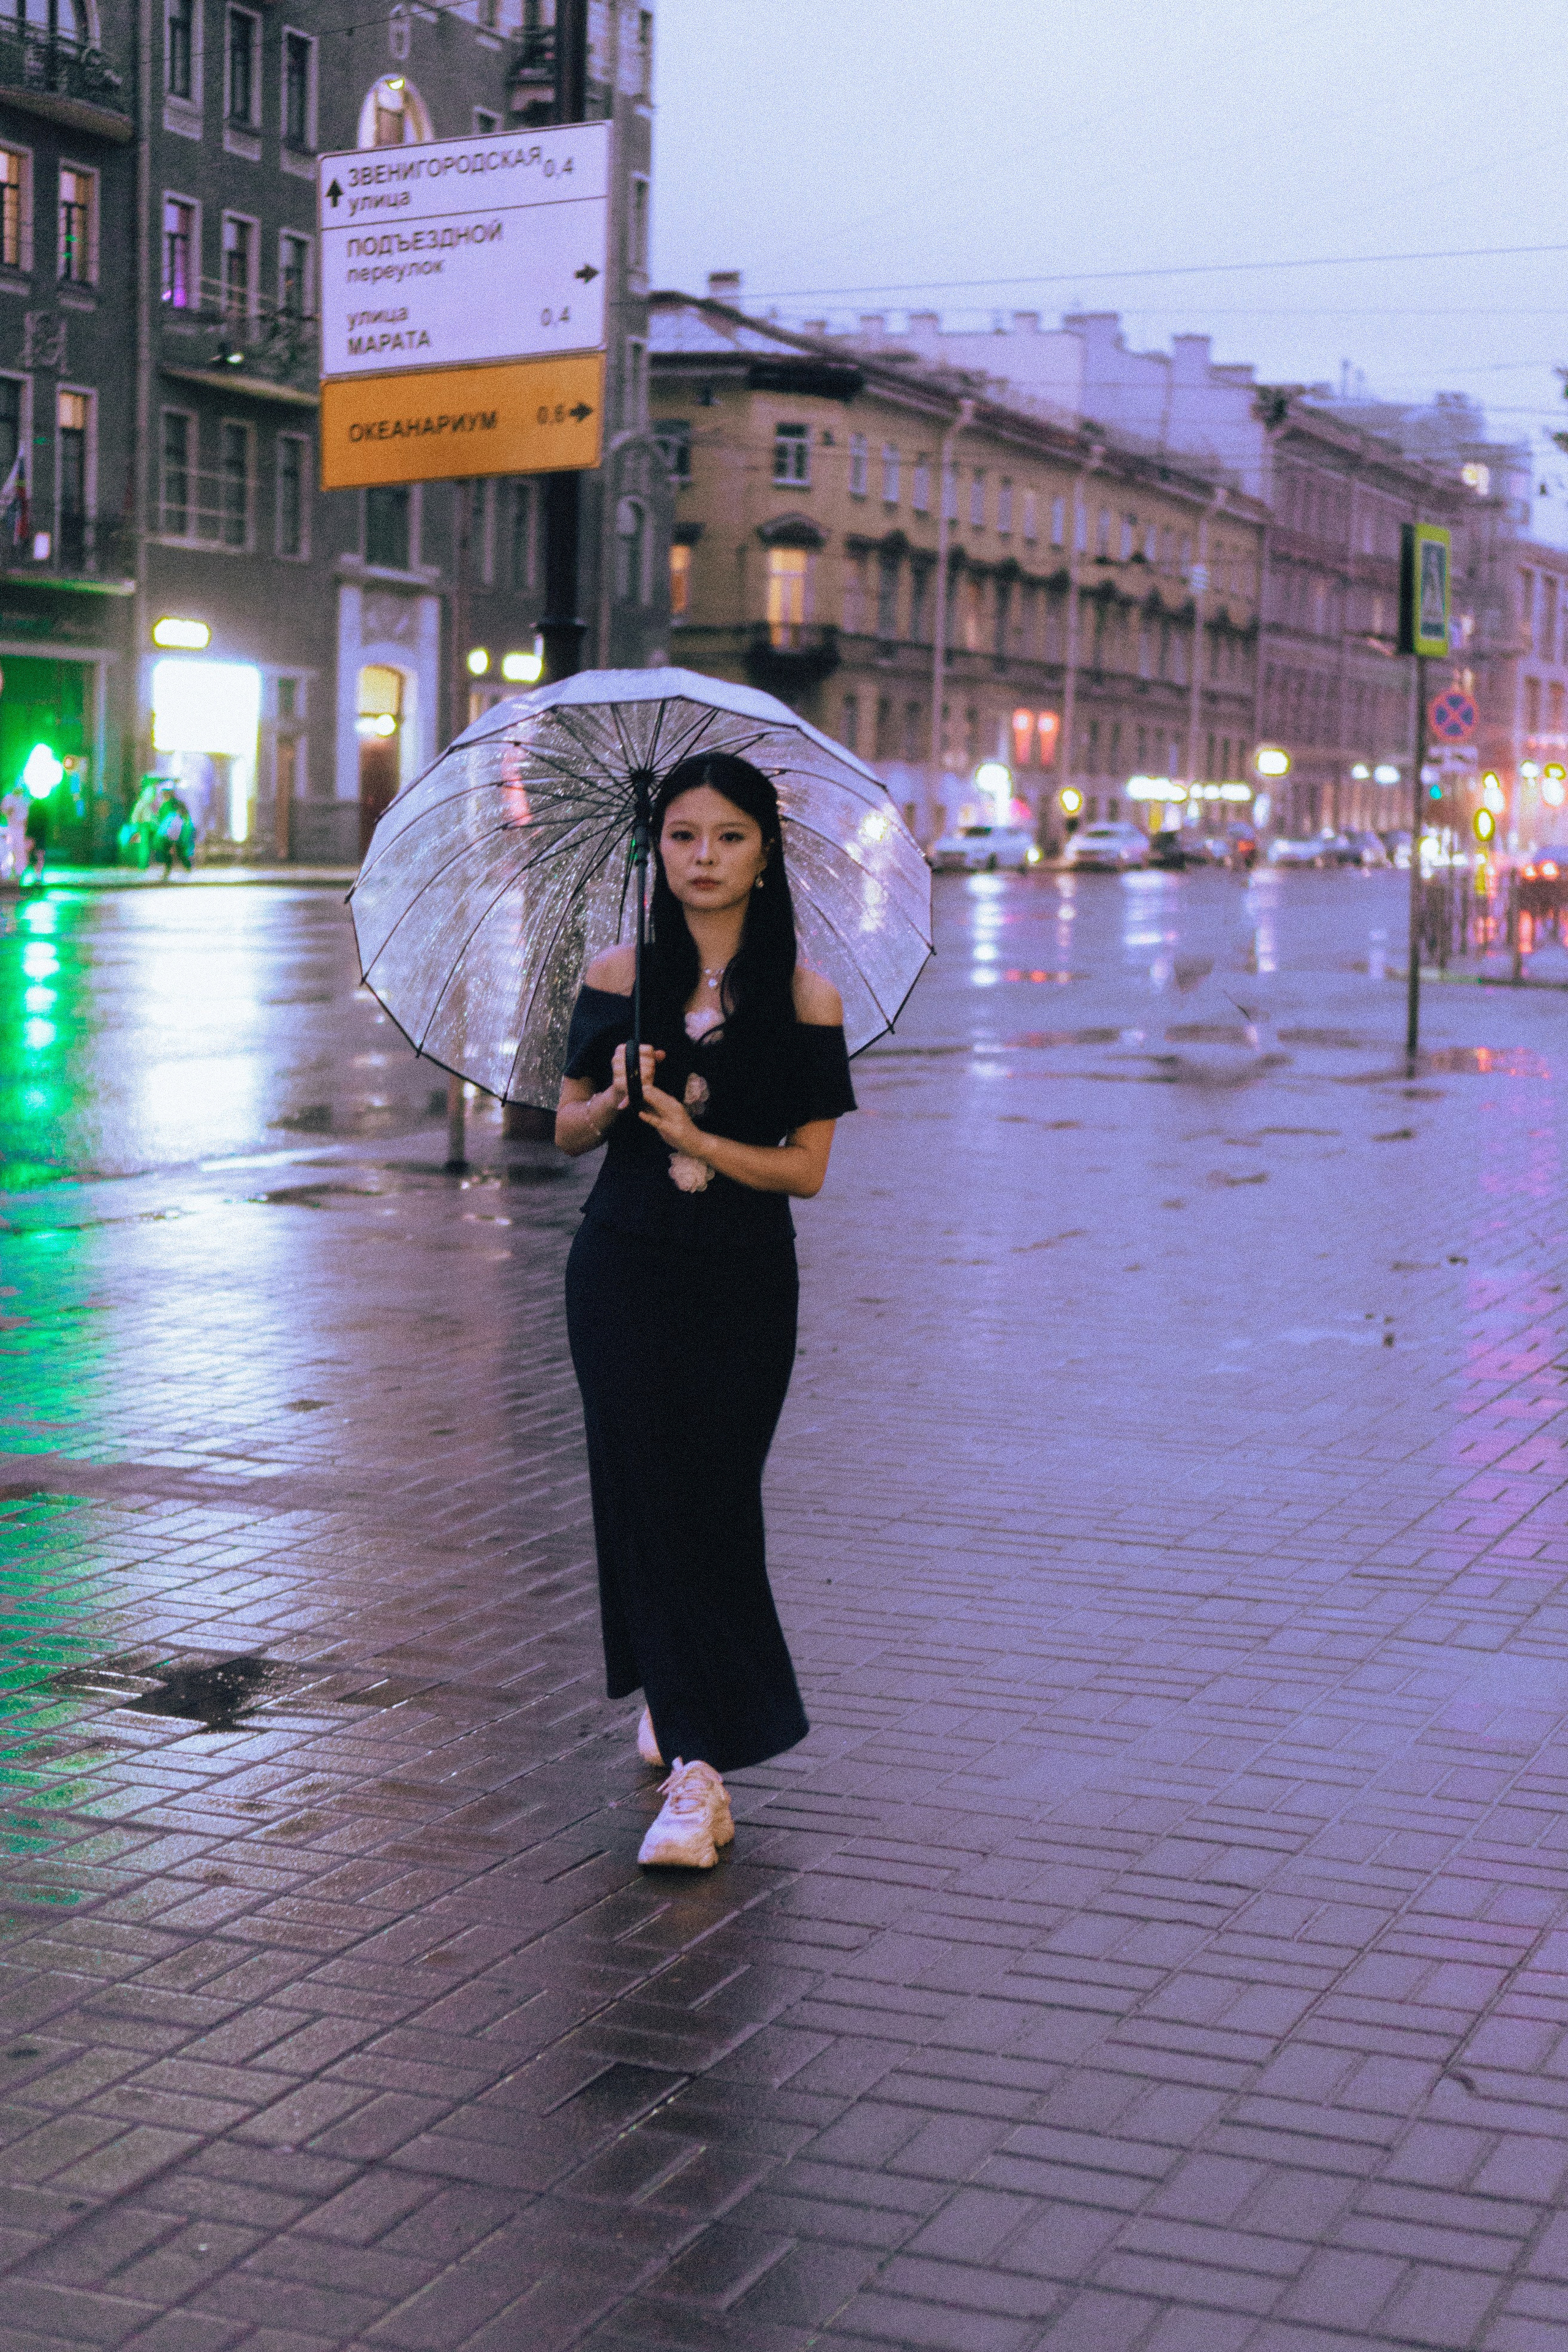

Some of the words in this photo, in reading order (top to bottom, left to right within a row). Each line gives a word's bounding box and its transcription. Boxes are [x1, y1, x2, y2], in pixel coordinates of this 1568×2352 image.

[349, 146, 541, 187] ЗВЕНИГОРОДСКАЯ
[349, 191, 411, 216] улица
[347, 219, 503, 257] ПОДЪЕЗДНОЙ
[347, 260, 443, 284] переулок
[347, 307, 408, 330] улица
[348, 331, 431, 355] МАРАТА
[349, 410, 498, 442] ОКЕАНАРИУМ
